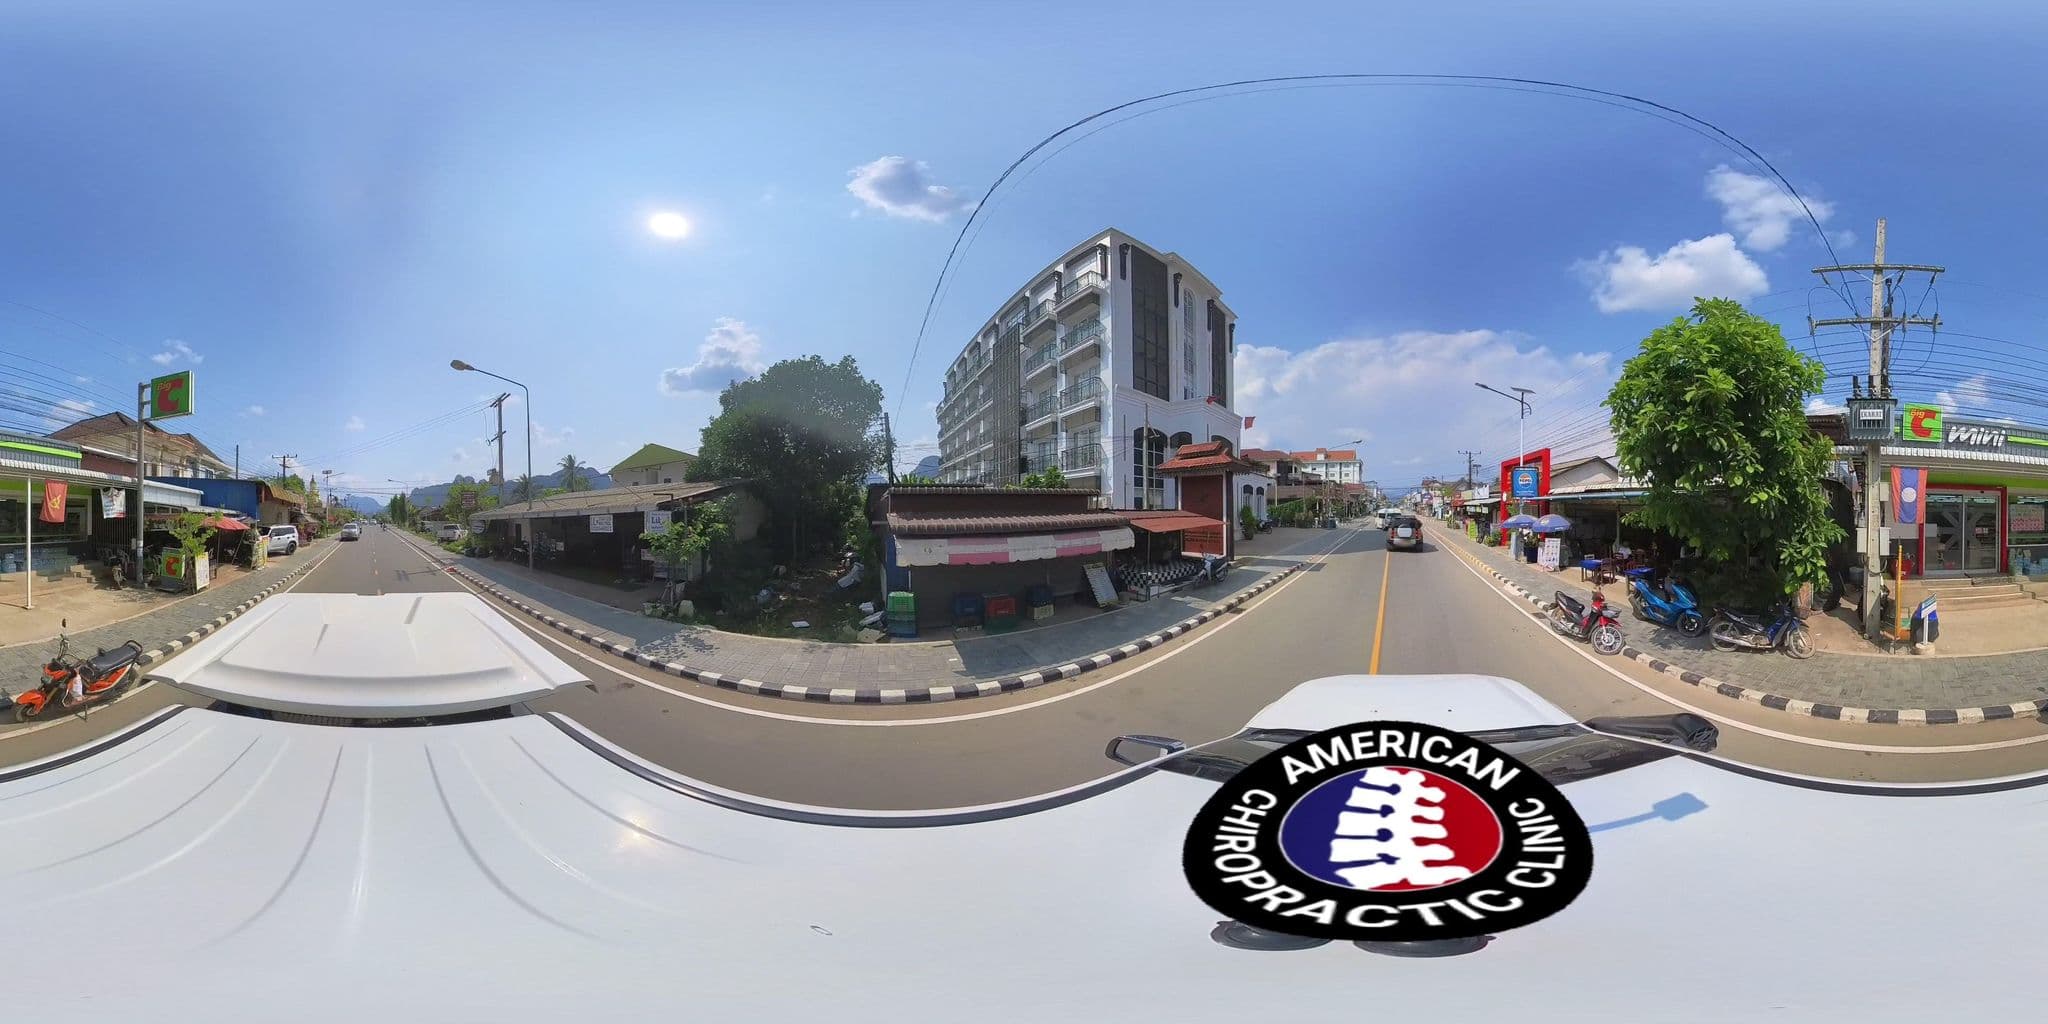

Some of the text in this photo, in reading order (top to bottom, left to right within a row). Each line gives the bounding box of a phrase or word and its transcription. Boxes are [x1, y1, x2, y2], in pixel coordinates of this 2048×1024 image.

[157, 379, 183, 411] Big C
[1910, 408, 2005, 447] Big C mini
